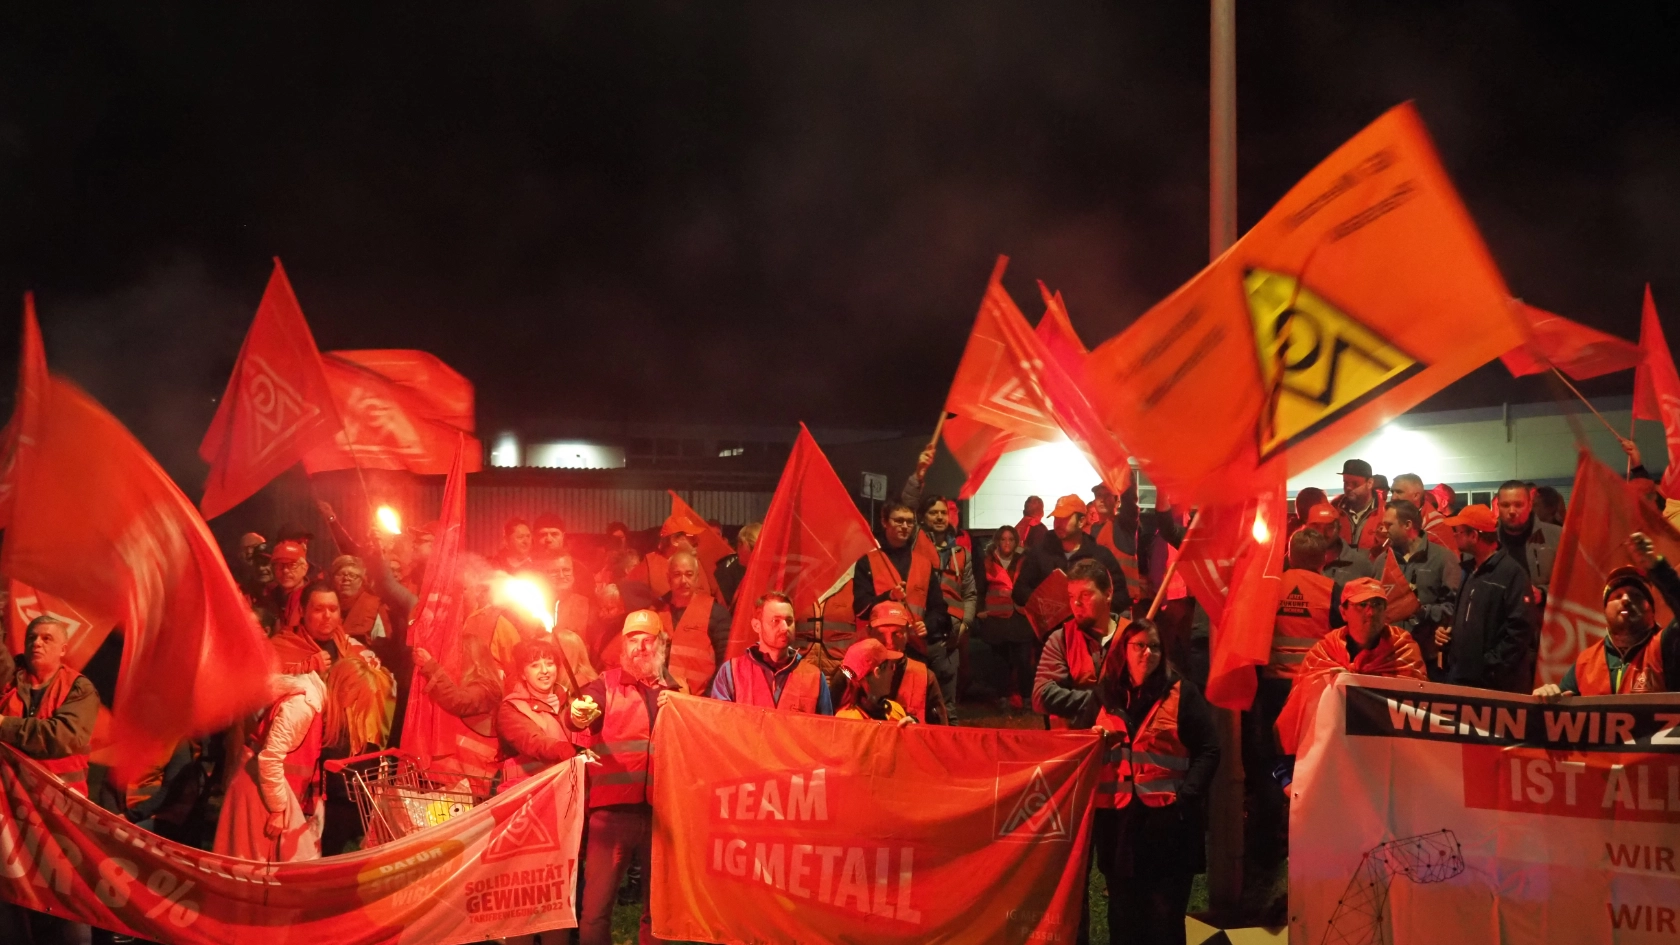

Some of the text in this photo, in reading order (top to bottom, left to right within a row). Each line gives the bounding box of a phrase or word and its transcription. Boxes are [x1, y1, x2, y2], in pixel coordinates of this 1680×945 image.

[1279, 600, 1309, 608] ZUKUNFT
[1387, 698, 1527, 740] WENN
[1543, 711, 1637, 745] WIR
[715, 768, 829, 821] TEAM
[1510, 757, 1586, 806] IST
[0, 804, 200, 928] ÜR 8 %
[1605, 842, 1676, 873] WIR
[464, 863, 564, 897] SOLIDARITÄT
[713, 838, 922, 925] IG METALL
[540, 901, 564, 913] 2022
[1606, 902, 1677, 935] WIR
[1021, 926, 1062, 942] Passau
